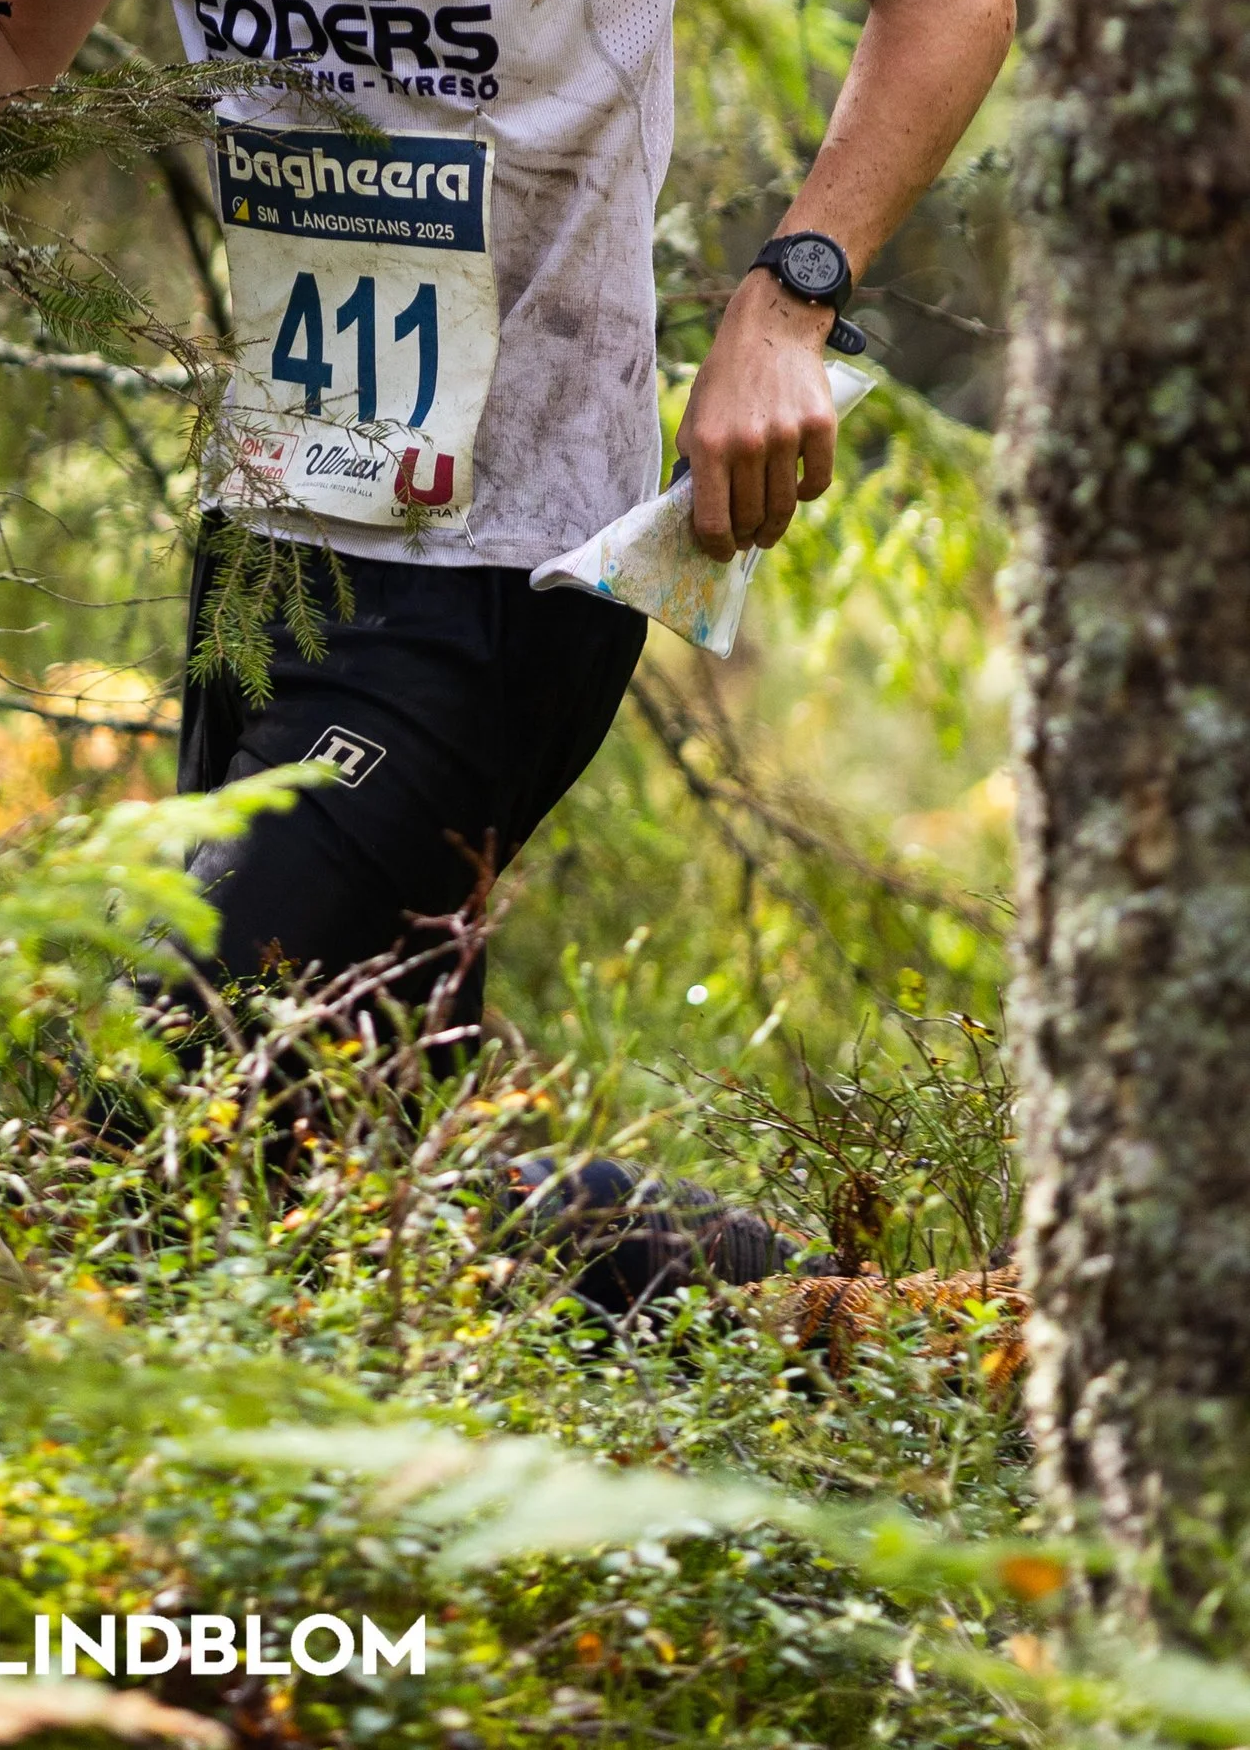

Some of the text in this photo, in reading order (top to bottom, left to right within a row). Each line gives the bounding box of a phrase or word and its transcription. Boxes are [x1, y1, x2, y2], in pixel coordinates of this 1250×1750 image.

[381, 73, 499, 100] TYRESÖ
[226, 134, 470, 201] bagheera
[257, 205, 455, 241] SM LÅNGDISTANS 2025
[797, 243, 826, 283] 36:15
[271, 271, 439, 428] 411
[306, 443, 385, 481] Ullmax
[391, 506, 453, 518] URA
